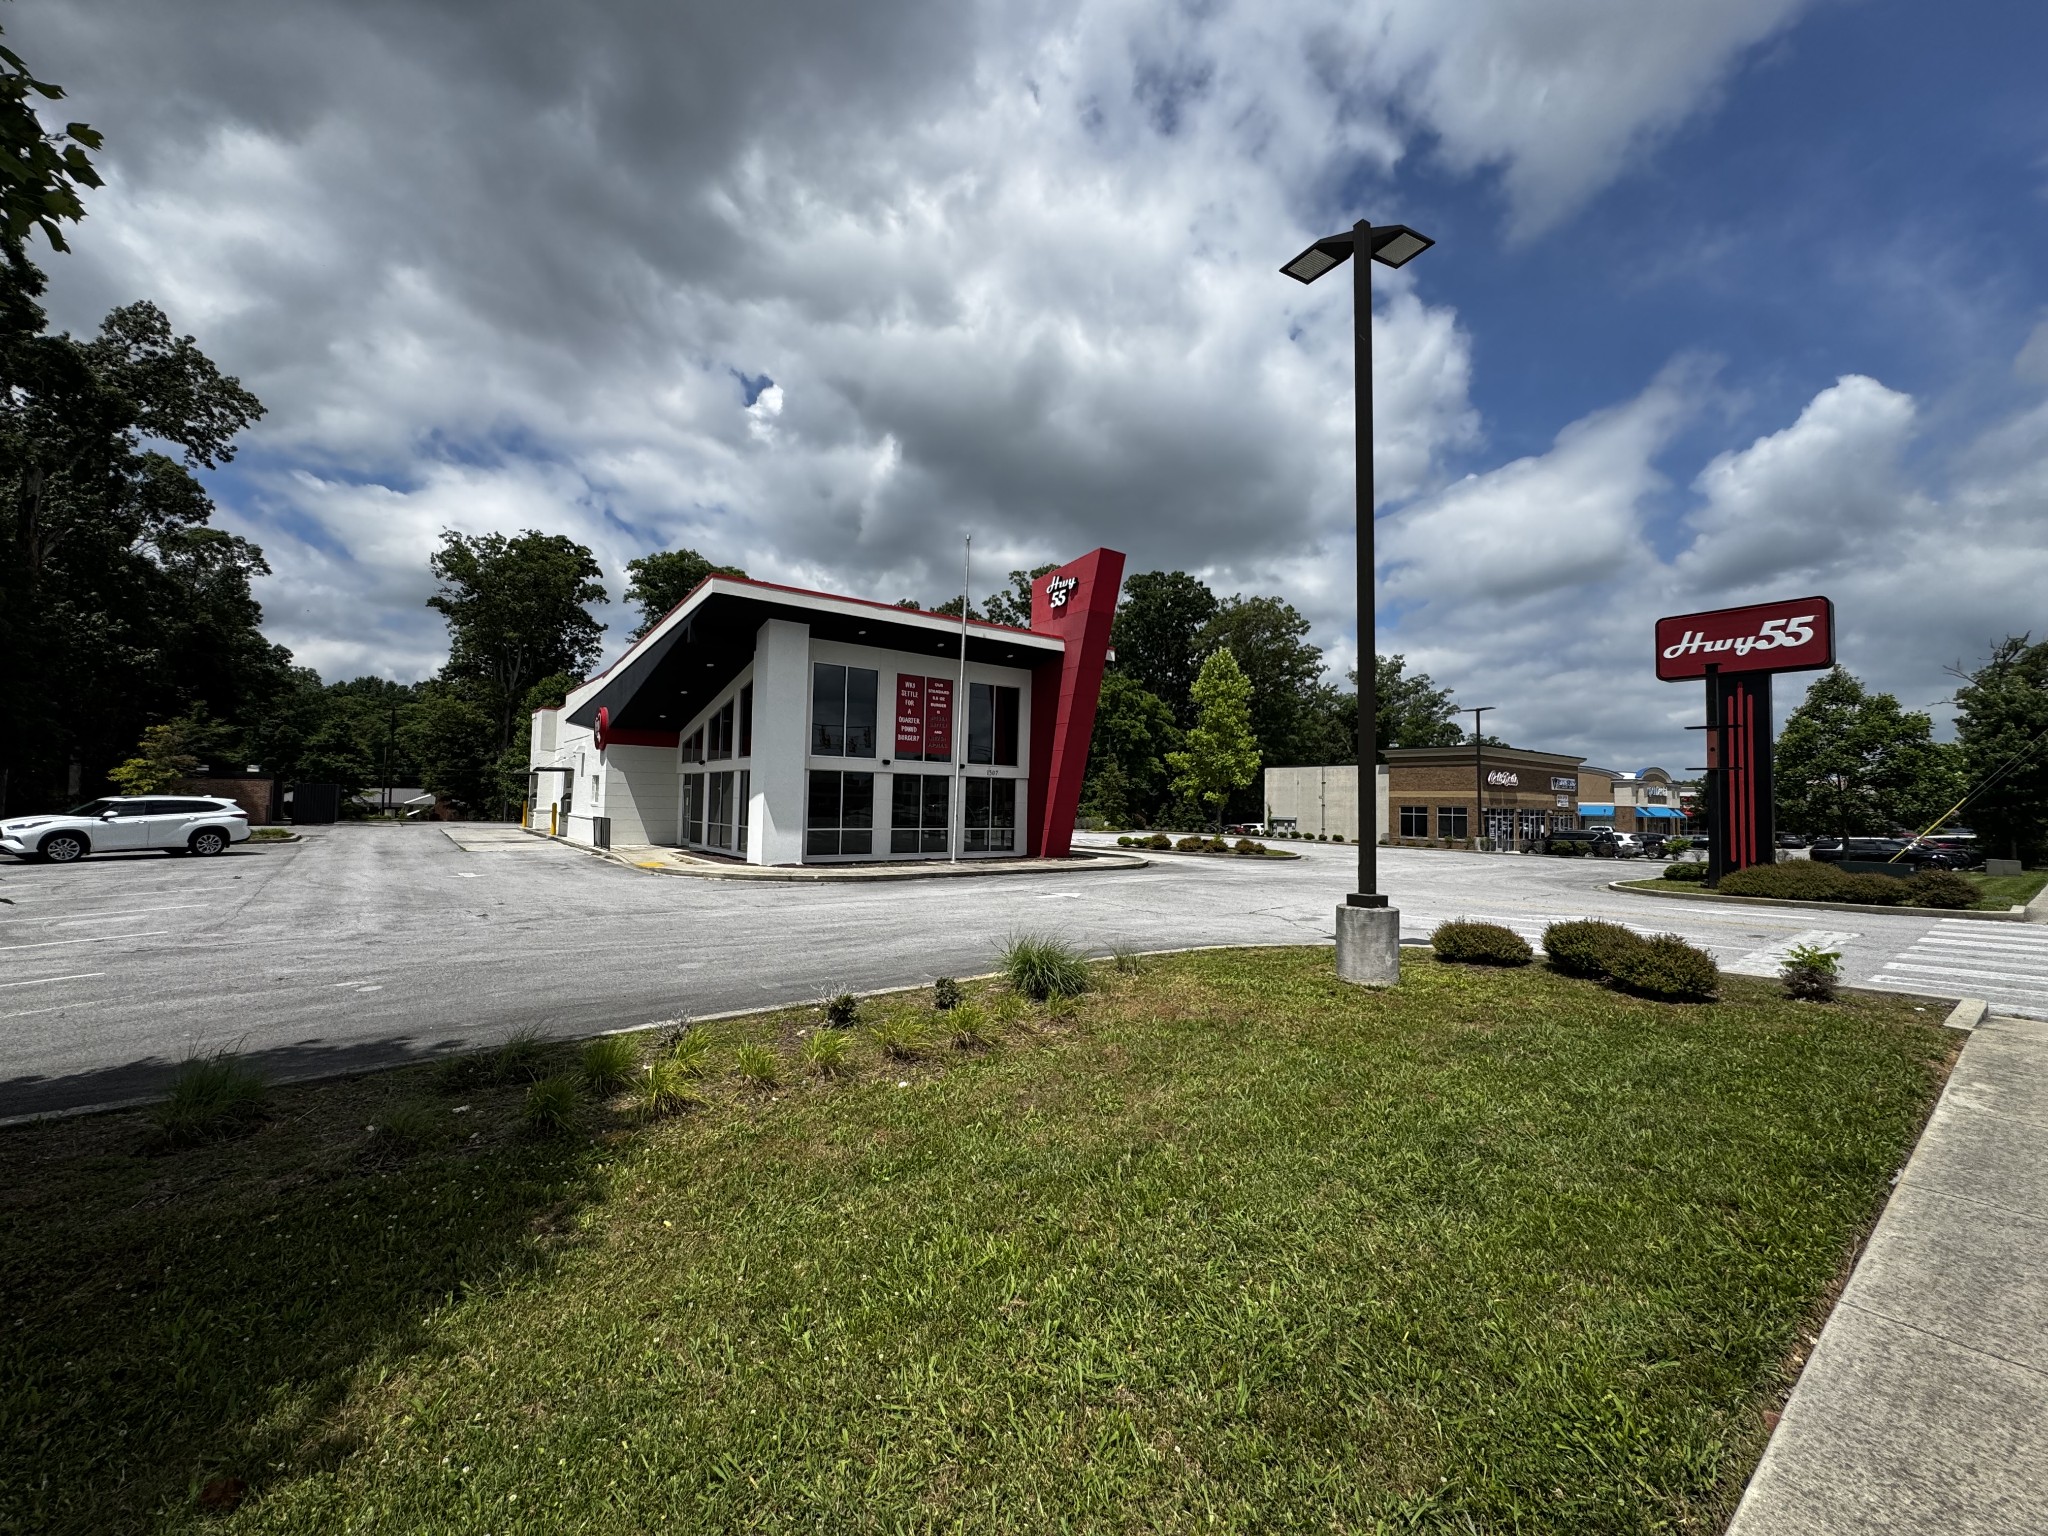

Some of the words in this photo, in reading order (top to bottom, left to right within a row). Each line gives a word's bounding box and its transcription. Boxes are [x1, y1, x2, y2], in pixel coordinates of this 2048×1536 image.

[1046, 576, 1076, 594] Hwy
[1050, 589, 1067, 608] 55
[901, 689, 919, 698] SETTLE
[905, 699, 915, 707] FOR
[898, 715, 921, 725] QUARTER
[901, 725, 918, 733] POUND
[897, 733, 920, 742] BURGER?
